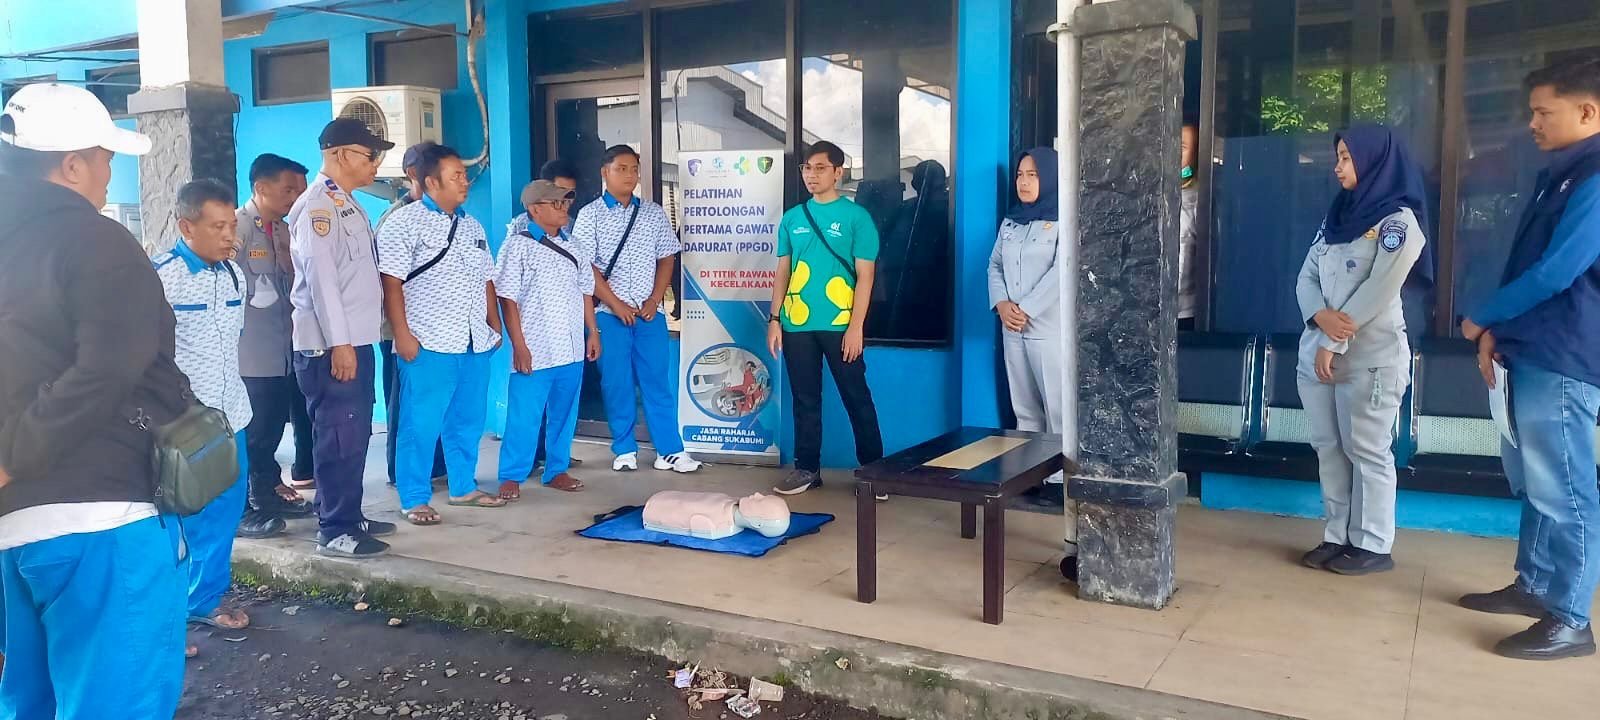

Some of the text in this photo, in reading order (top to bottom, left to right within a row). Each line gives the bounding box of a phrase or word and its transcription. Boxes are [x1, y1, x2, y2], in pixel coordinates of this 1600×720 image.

[684, 188, 742, 199] PELATIHAN
[684, 206, 765, 217] PERTOLONGAN
[684, 223, 775, 235] PERTAMA GAWAT
[684, 242, 774, 254] DARURAT (PPGD)
[700, 270, 776, 278] DI TITIK RAWAN
[710, 280, 775, 288] KECELAKAAN
[700, 427, 756, 436] JASA RAHARJA
[692, 434, 764, 445] CABANG SUKABUMI
